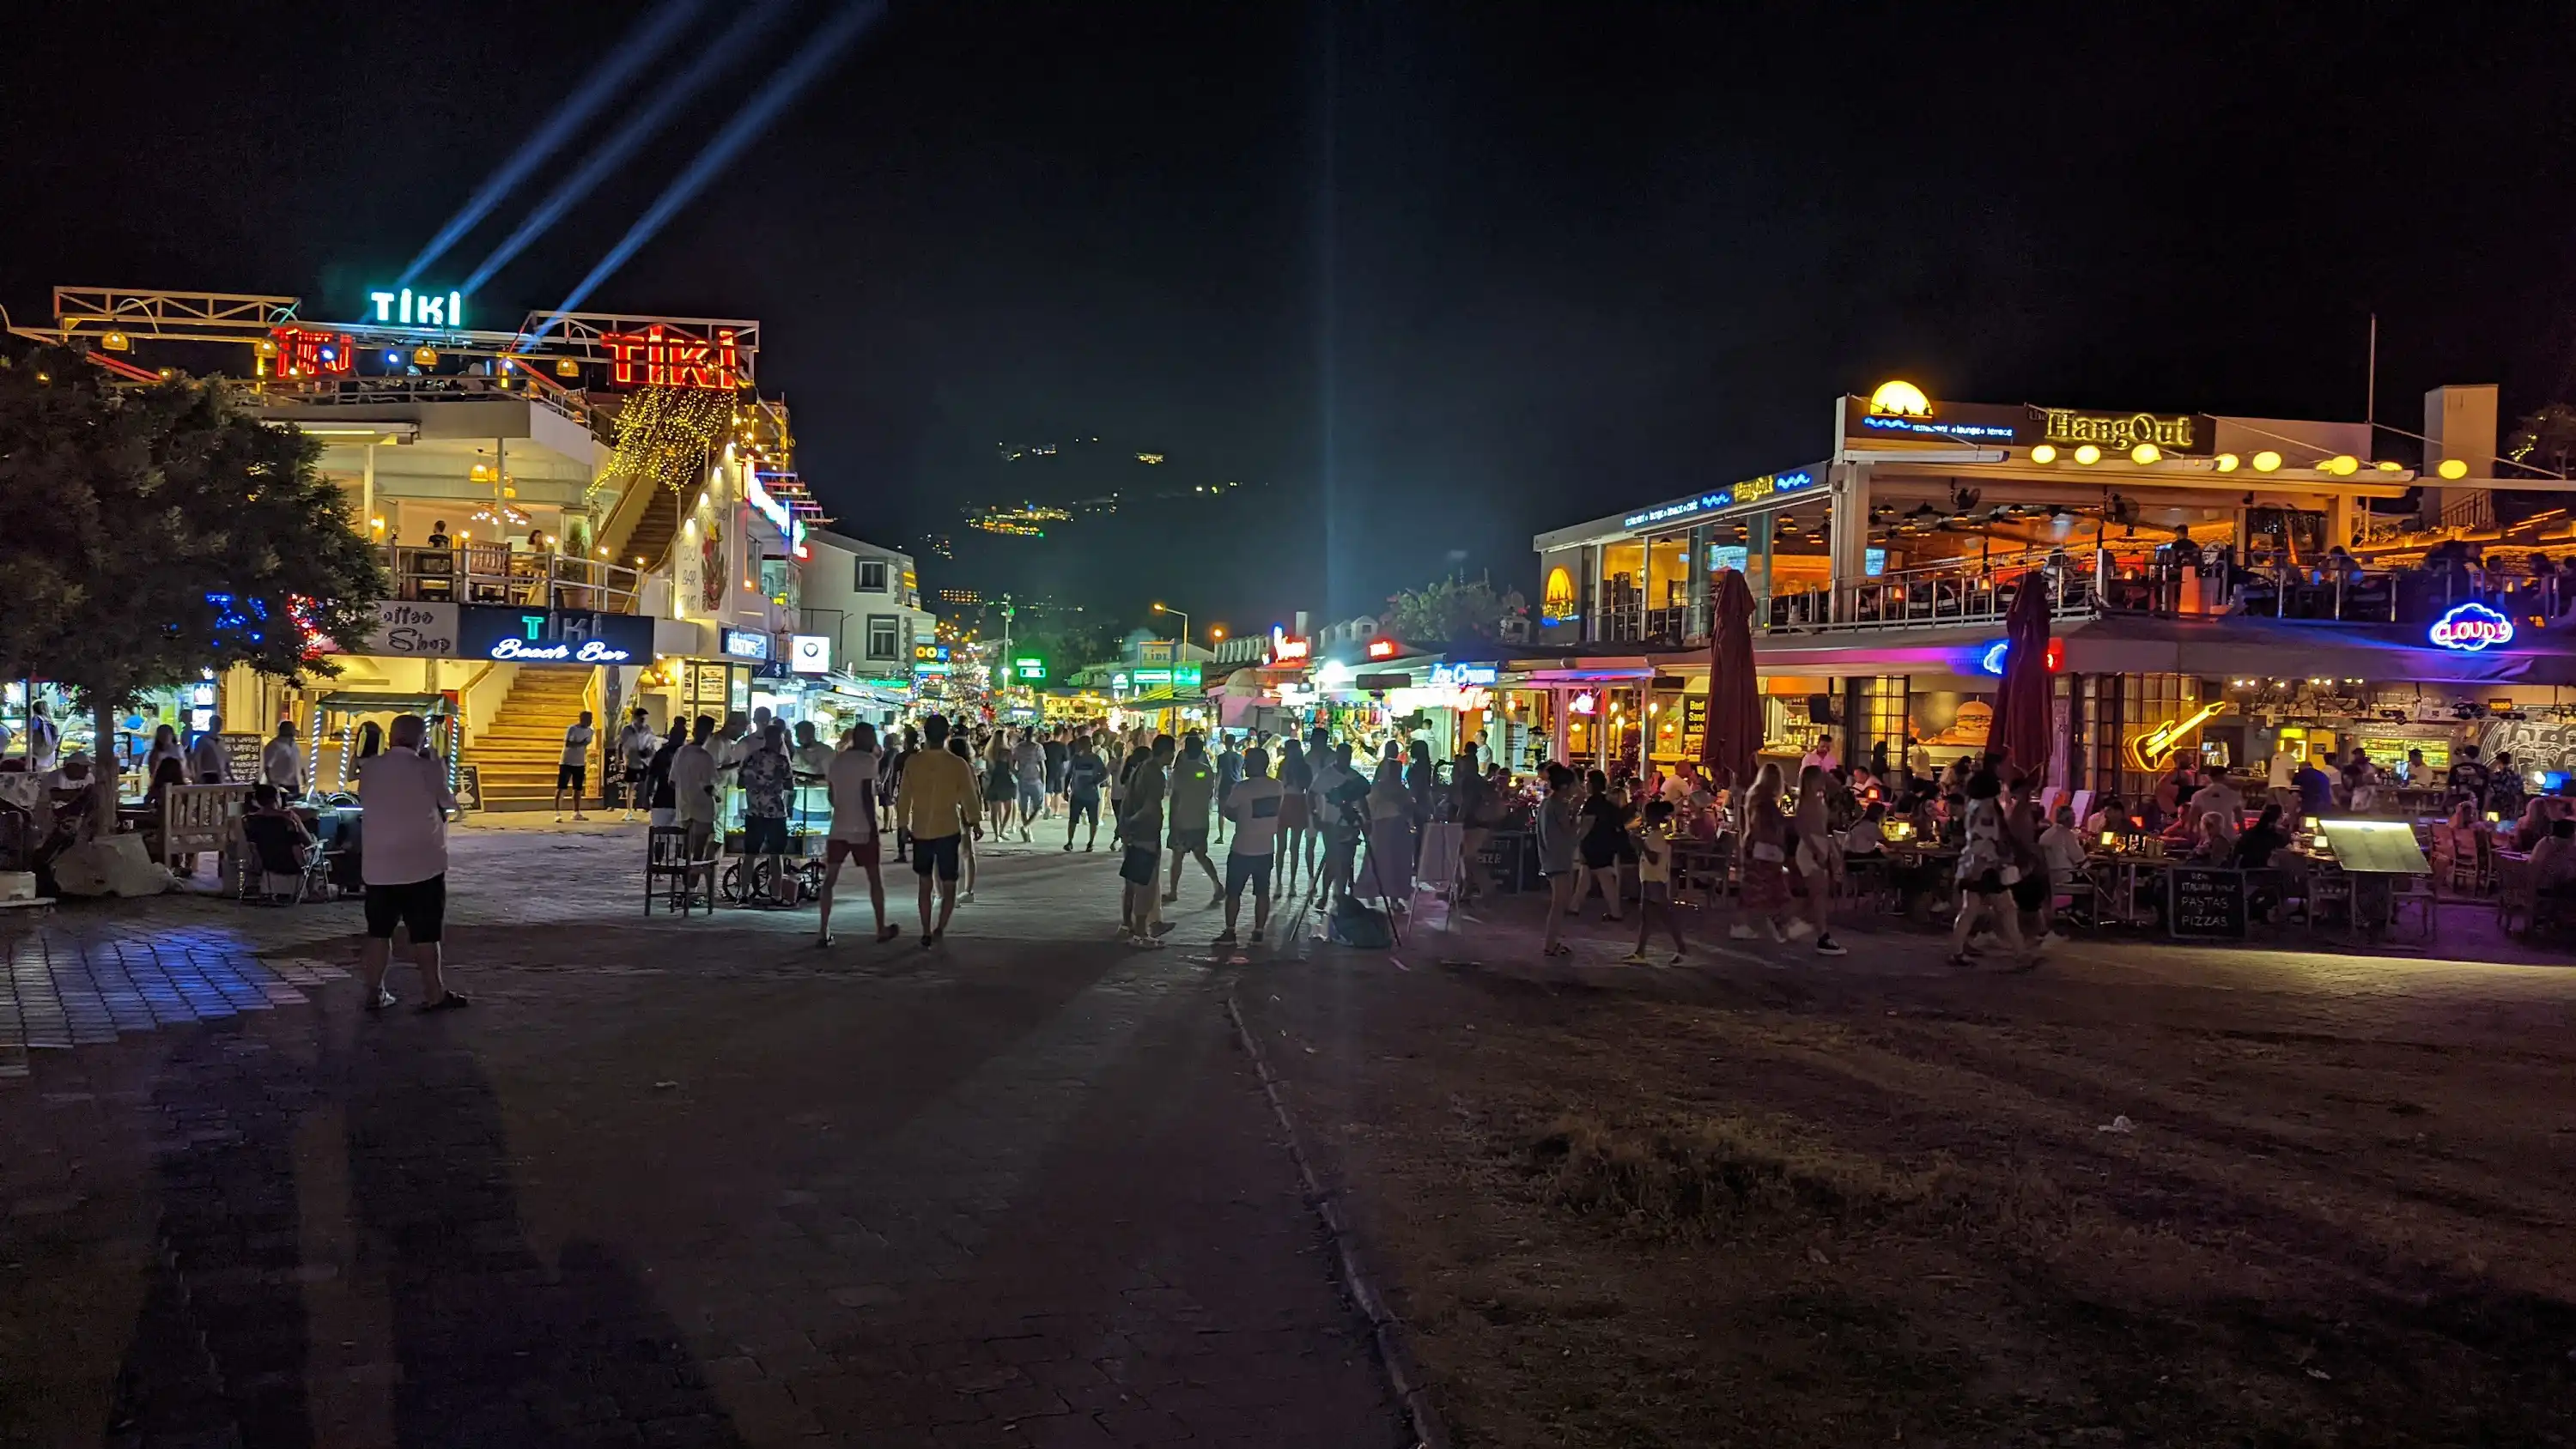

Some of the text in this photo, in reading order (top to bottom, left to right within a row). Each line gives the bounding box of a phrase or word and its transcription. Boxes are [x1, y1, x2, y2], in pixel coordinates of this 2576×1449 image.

[1987, 427, 2012, 436] terrace
[2045, 409, 2193, 450] HangOut
[2437, 621, 2496, 640] CLOUD
[387, 627, 452, 654] Shop
[491, 638, 629, 661] Beach Bar
[1429, 663, 1453, 683] Ice
[1689, 700, 1705, 711] Beef
[1689, 712, 1705, 722] Sand
[2181, 896, 2229, 909] PASTAS
[2181, 915, 2228, 926] PIZZAS
